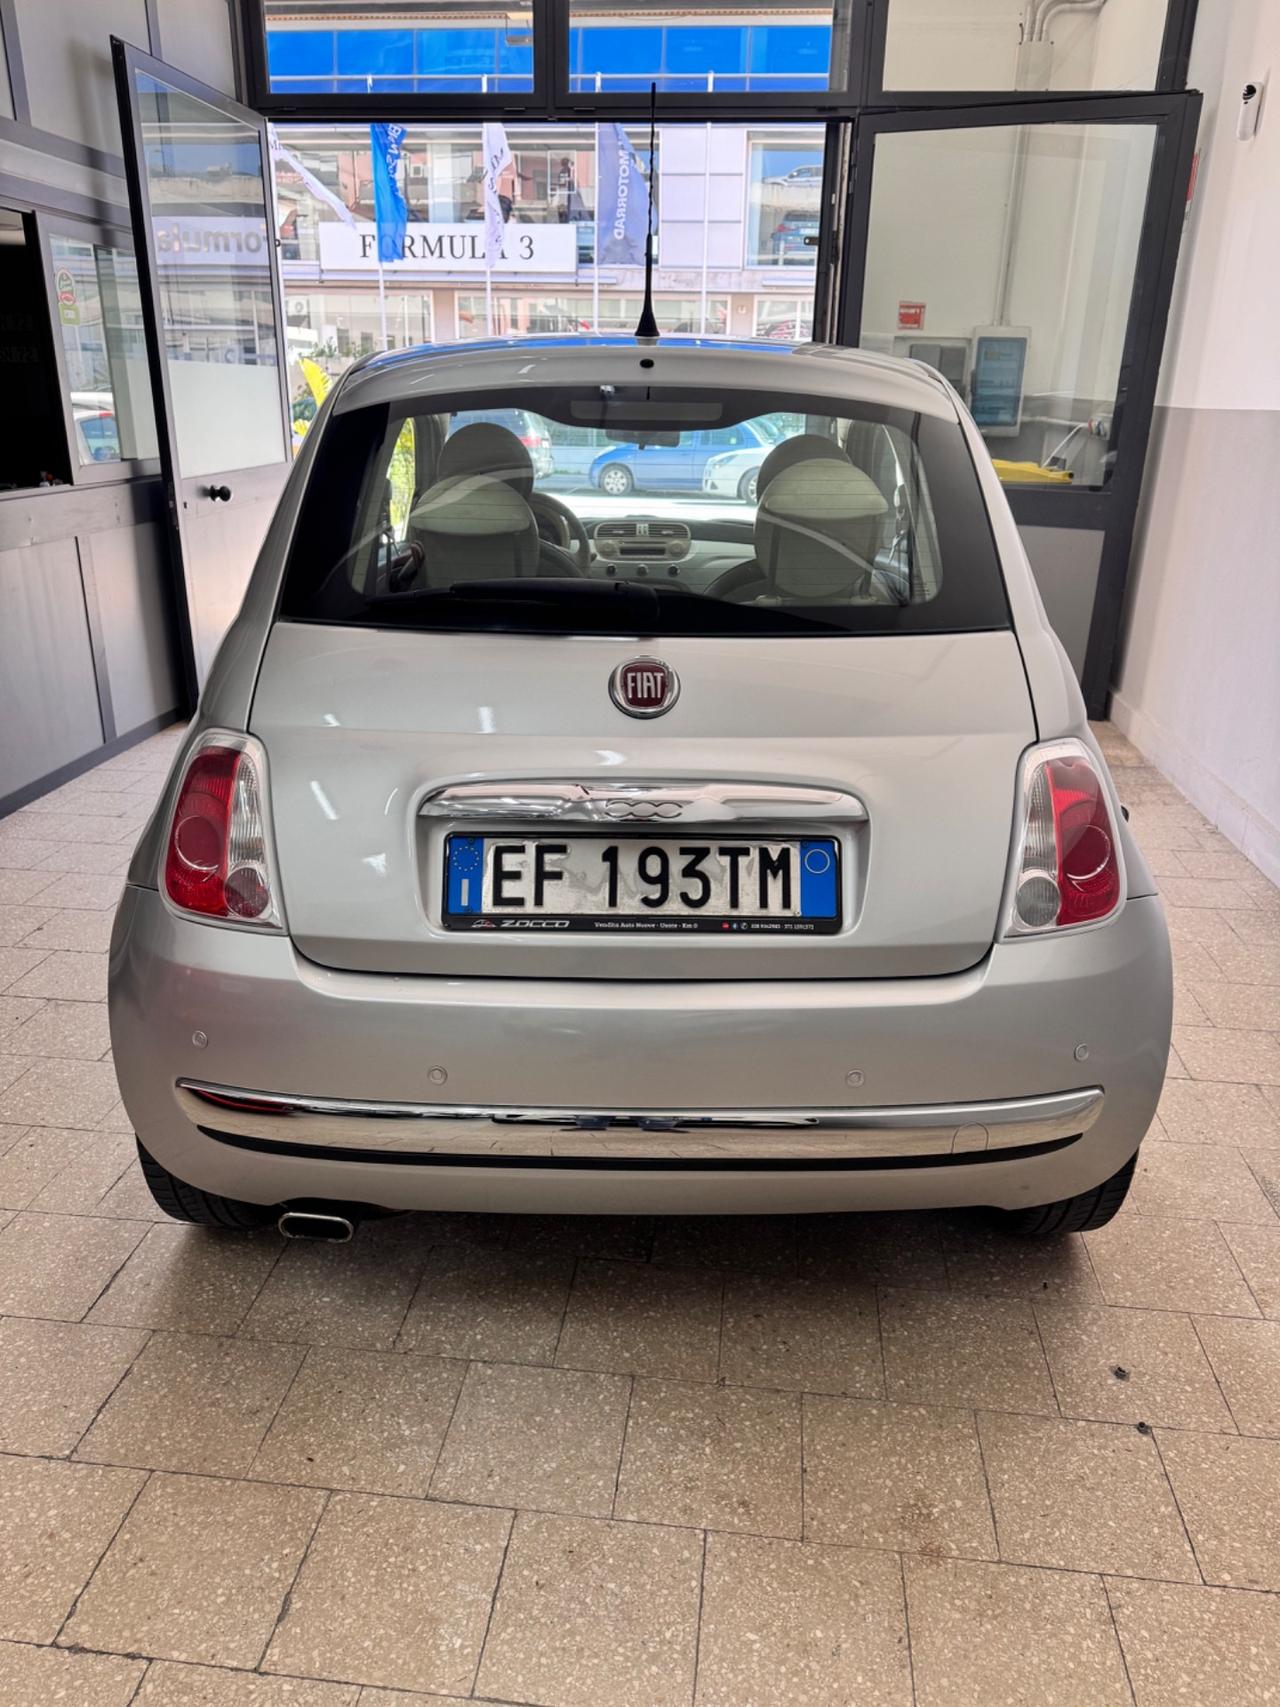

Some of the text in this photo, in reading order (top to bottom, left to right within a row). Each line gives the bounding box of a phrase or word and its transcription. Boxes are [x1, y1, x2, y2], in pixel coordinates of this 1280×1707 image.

[520, 234, 535, 260] 3
[626, 671, 664, 699] FIAT
[492, 844, 569, 909] EF
